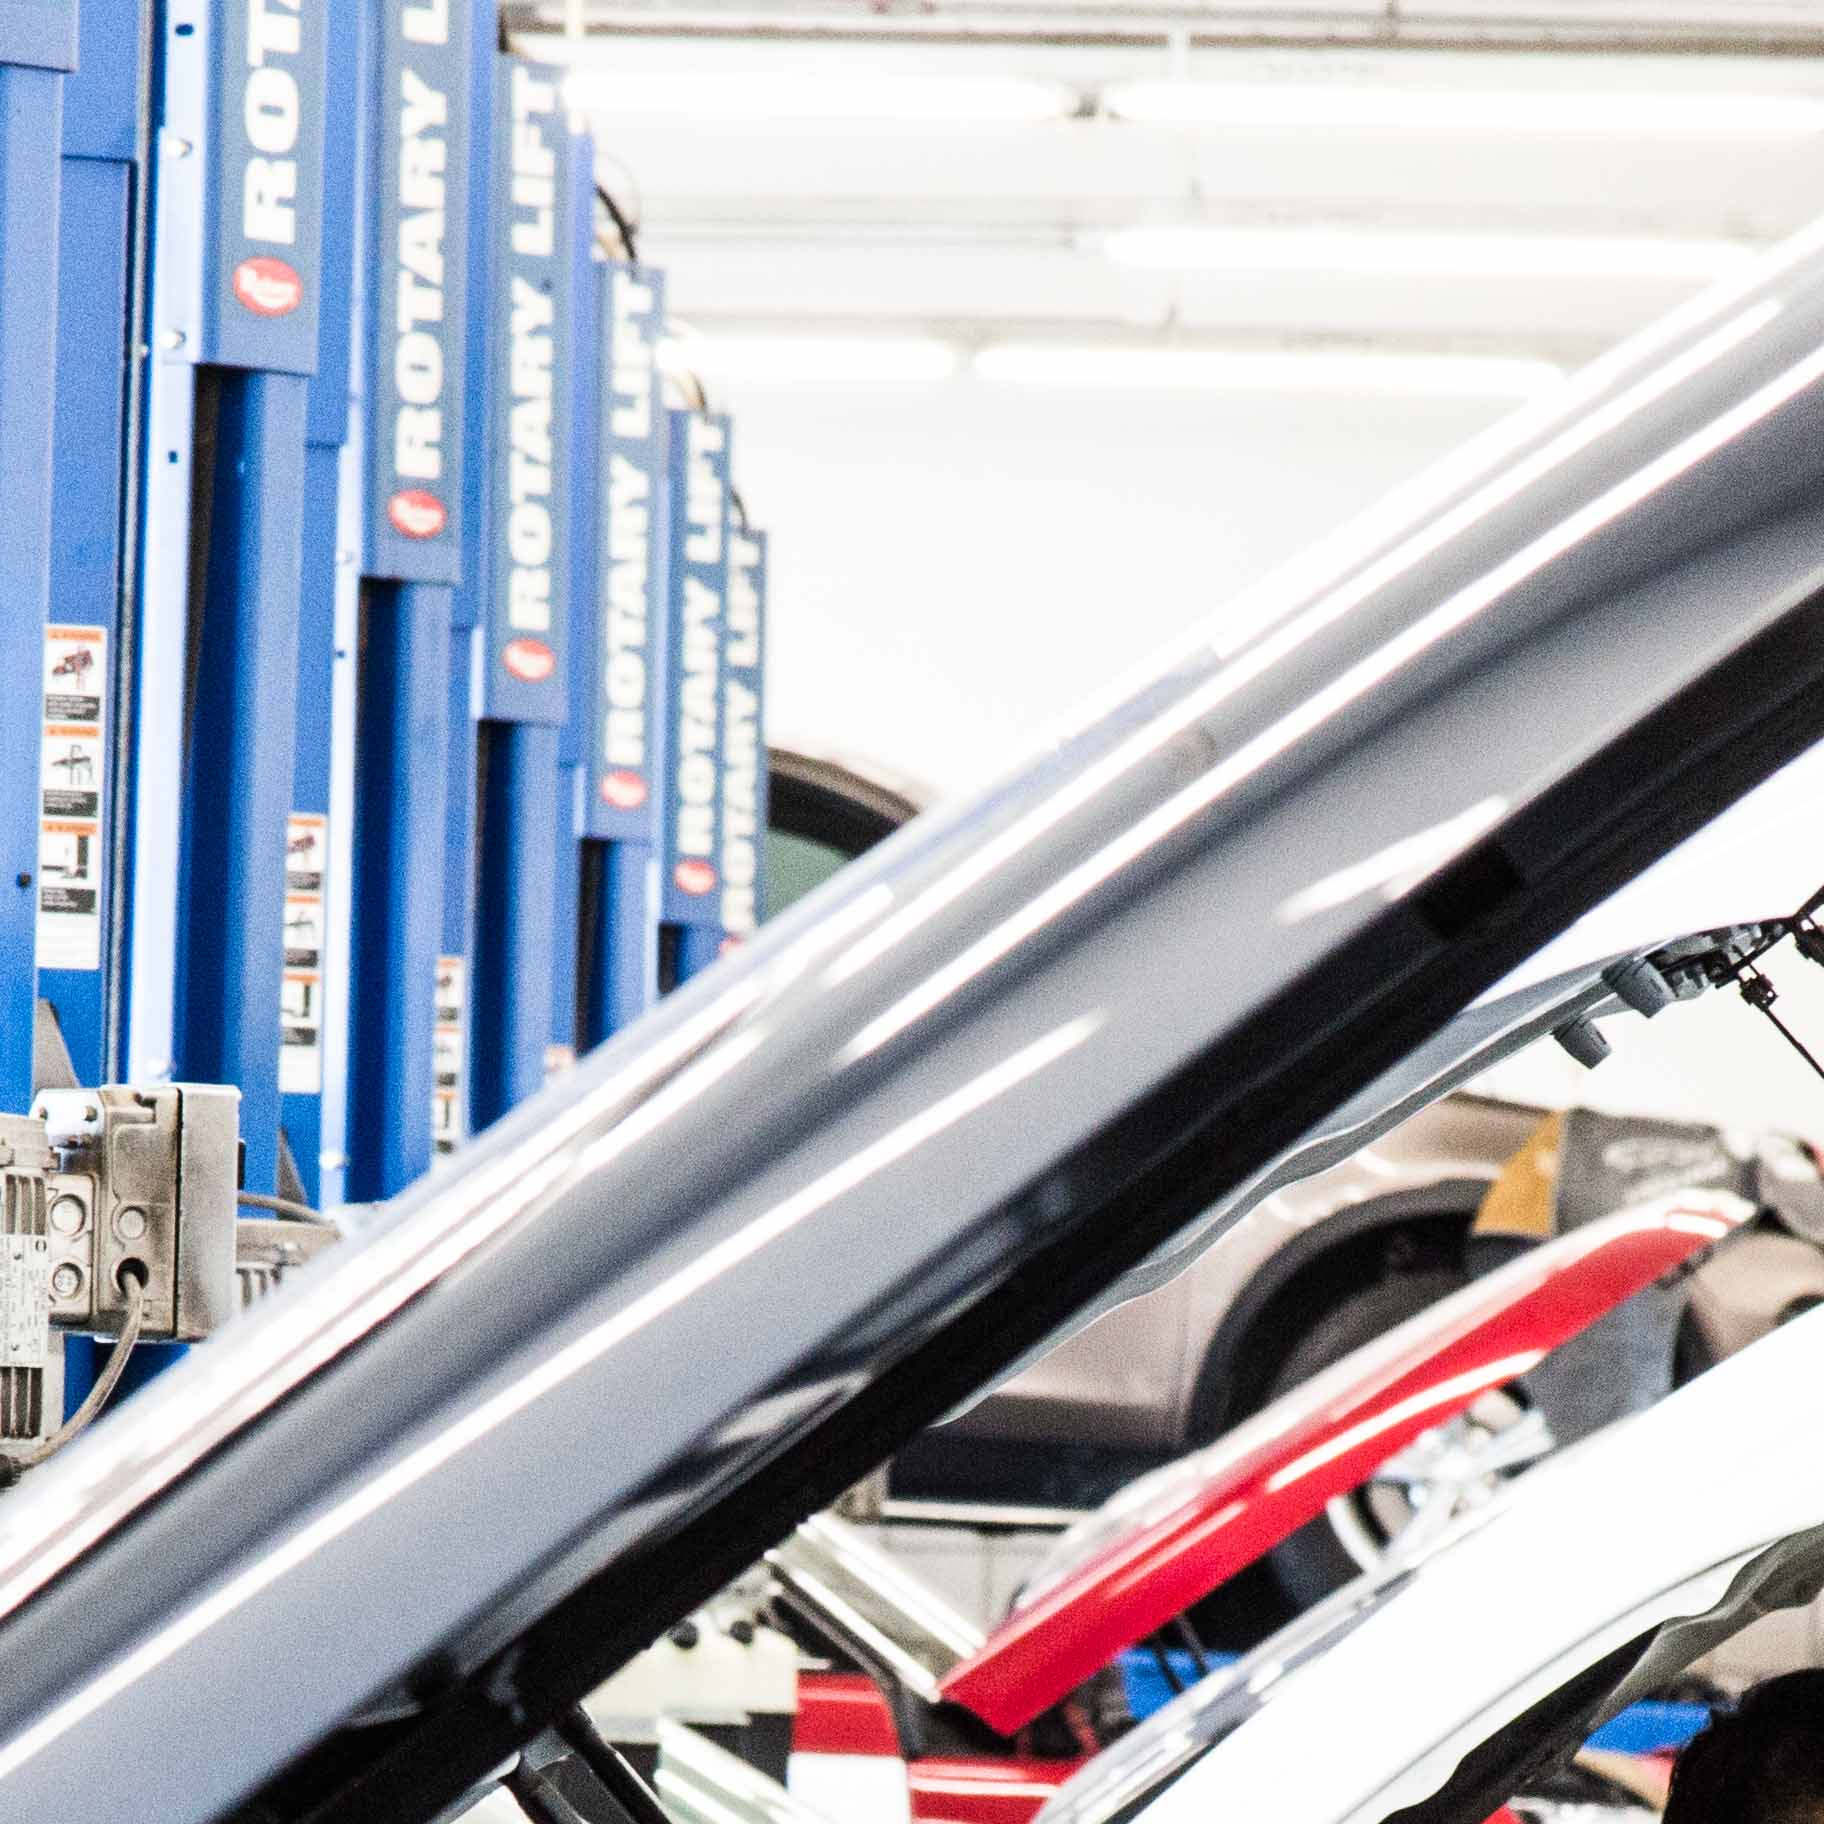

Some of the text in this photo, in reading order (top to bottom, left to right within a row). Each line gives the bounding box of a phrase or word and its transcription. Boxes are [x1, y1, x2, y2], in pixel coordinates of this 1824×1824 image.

[242, 0, 302, 245] ROT
[395, 65, 448, 480] ROTARY
[512, 66, 556, 255] LIFT
[508, 276, 555, 632] ROTARY
[606, 270, 653, 766] ROTARY LIFT
[678, 415, 724, 855] ROTARY LIFT
